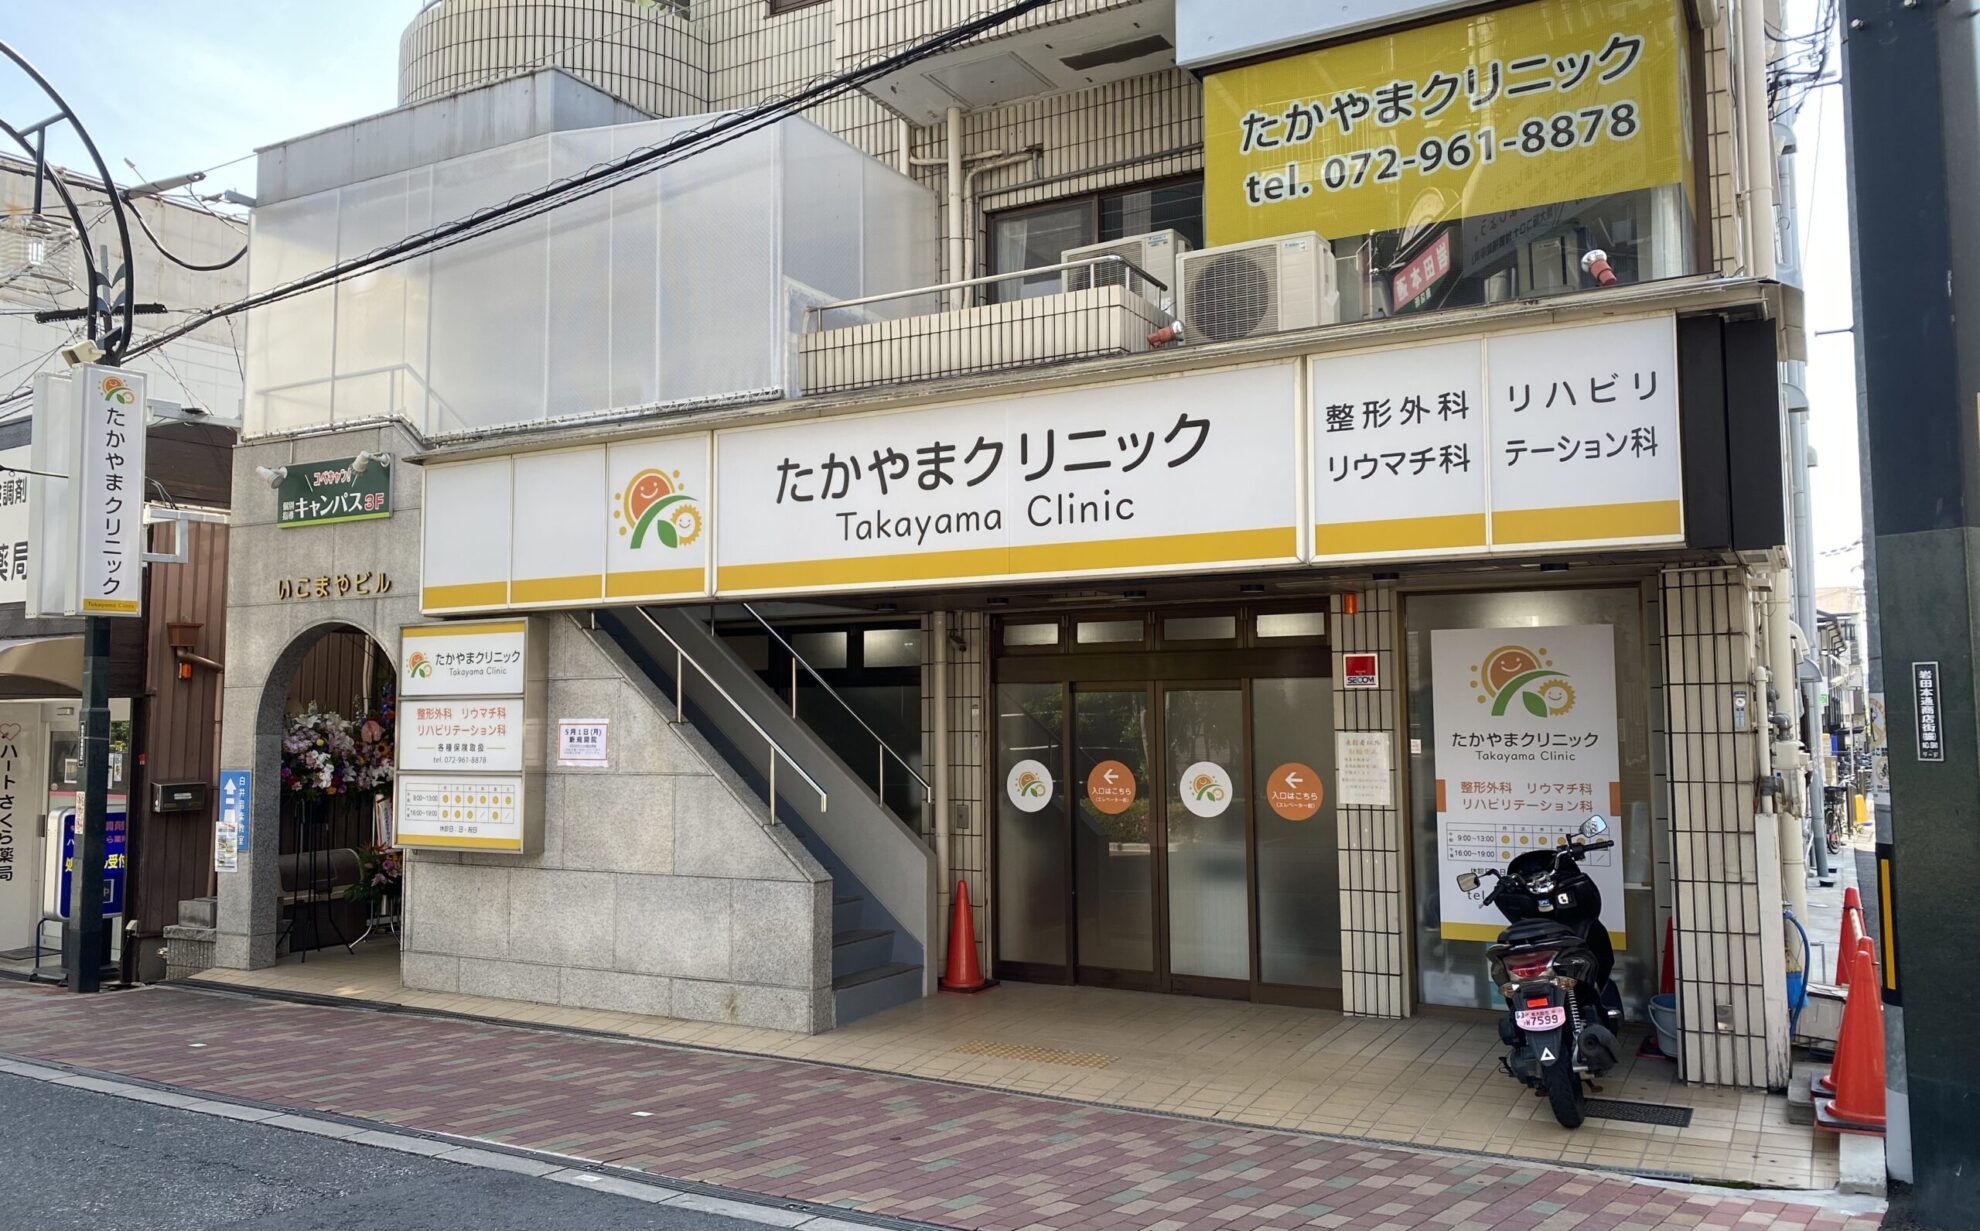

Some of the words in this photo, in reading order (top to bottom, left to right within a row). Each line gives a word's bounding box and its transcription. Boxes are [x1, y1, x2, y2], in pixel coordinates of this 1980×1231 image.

[1240, 36, 1643, 153] たかやまクリニック
[1246, 164, 1310, 204] tel.
[1323, 103, 1637, 190] 072-961-8878
[1508, 370, 1658, 413] リハビリ
[1325, 390, 1469, 433] 整形外科
[1505, 425, 1659, 467] テーション科
[776, 412, 1211, 504] たかやまクリニック
[1328, 442, 1471, 482] リウマチ科
[0, 475, 27, 507] 調剤
[102, 407, 127, 595] たかやまクリニック
[295, 492, 363, 519] キャンパス
[364, 492, 385, 511] 3F
[836, 509, 1002, 545] Takayama
[1027, 490, 1135, 527] Clinic
[278, 571, 392, 600] いこまやビル
[435, 650, 521, 666] たかやまクリニック
[449, 668, 484, 678] Takayama
[486, 666, 508, 675] Clinic
[1347, 676, 1375, 684] SECOM
[416, 707, 452, 720] 整形外科
[461, 707, 507, 719] リウマチ科
[417, 724, 506, 737] リハビリテーション科
[1452, 732, 1599, 748] たかやまクリニック
[1475, 750, 1536, 763] Takayama
[1540, 750, 1576, 761] Clinic
[1091, 786, 1132, 796] 入口はこちら
[1271, 791, 1318, 801] 入口はこちら
[1461, 781, 1512, 794] 整形外科
[1527, 782, 1593, 796] リウマチ科
[1463, 798, 1593, 813] リハビリテーション科
[1530, 1014, 1559, 1026] 7599
